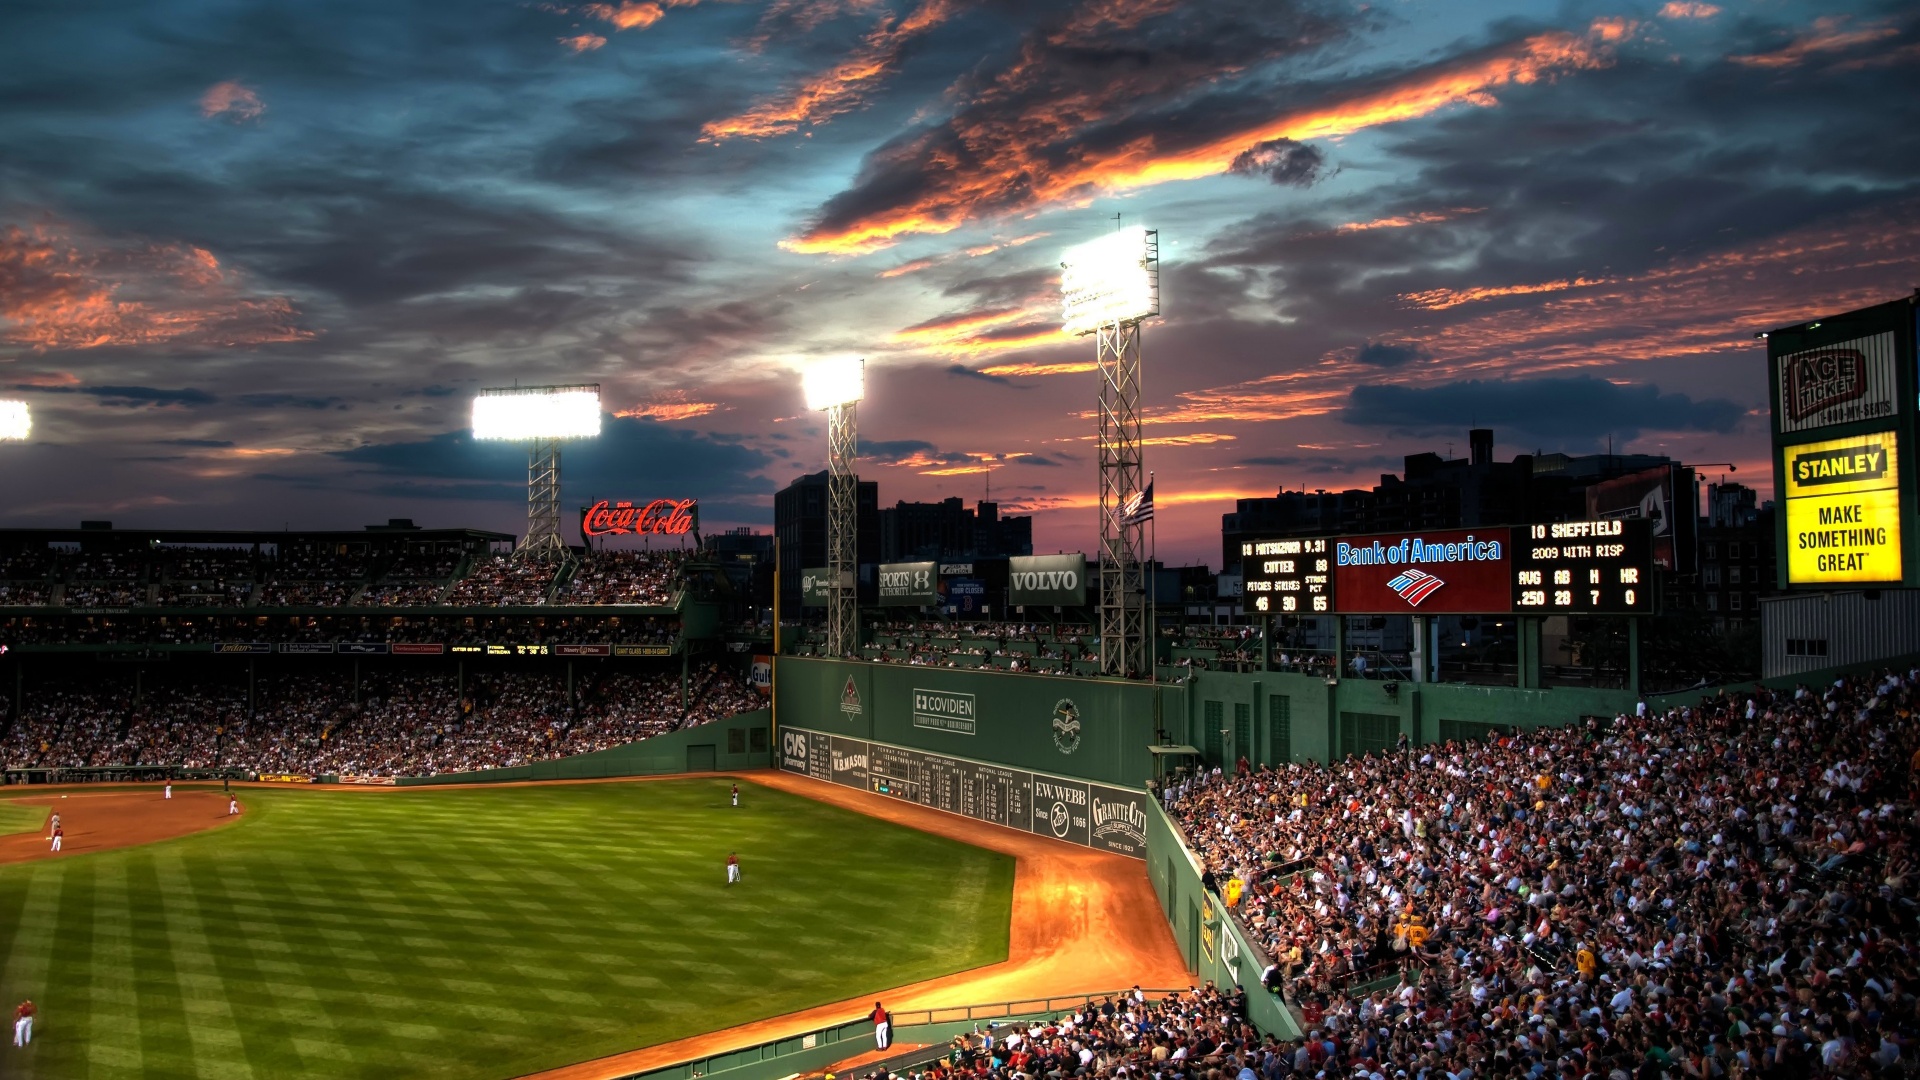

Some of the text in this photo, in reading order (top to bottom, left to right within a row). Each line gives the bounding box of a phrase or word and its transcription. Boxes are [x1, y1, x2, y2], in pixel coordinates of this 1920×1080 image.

[1799, 356, 1856, 387] ACE
[1800, 379, 1855, 410] TICKET
[1798, 452, 1880, 479] STANLEY
[583, 498, 697, 536] Coca-Cola
[1819, 505, 1862, 525] MAKE
[1531, 520, 1622, 539] 10 SHEFFIELD
[1798, 527, 1886, 549] SOMETHING
[1336, 535, 1501, 566] Bank of America
[1532, 544, 1625, 559] 2009 WITH RISP
[1264, 561, 1295, 573] CUTTER
[1554, 570, 1570, 584] AB
[1590, 569, 1599, 584] H
[1620, 567, 1638, 583] HR
[879, 571, 910, 587] SPORTS
[1011, 570, 1078, 591] VOLVO
[965, 587, 984, 595] CLOSER
[1517, 589, 1635, 605] .250 28 7 0
[1256, 596, 1327, 611] 46 30 65
[928, 696, 972, 716] COVIDIEN
[783, 732, 806, 758] CVS
[783, 756, 806, 771] pharmacy
[1035, 781, 1086, 806] F.W. WEBB
[1035, 808, 1086, 828] Since 1866
[1092, 797, 1128, 826] GRANITE
[1112, 823, 1130, 832] SUPPLY
[1107, 841, 1134, 853] SINCE 1923
